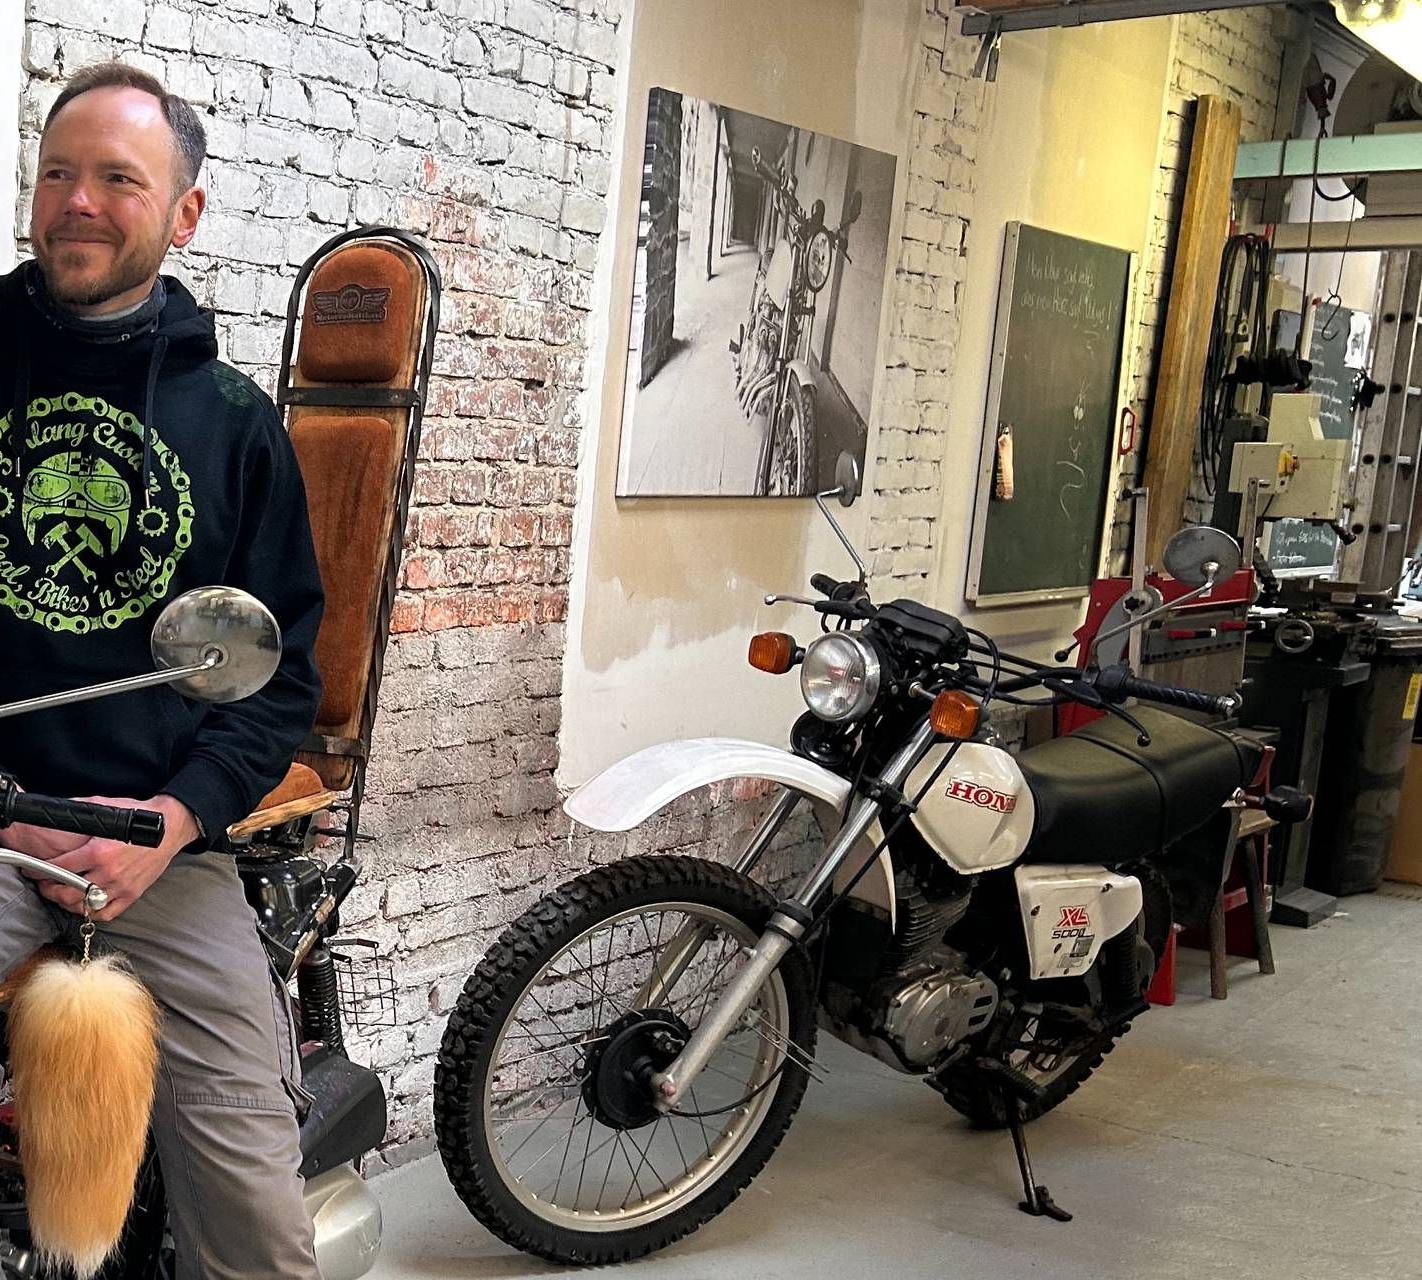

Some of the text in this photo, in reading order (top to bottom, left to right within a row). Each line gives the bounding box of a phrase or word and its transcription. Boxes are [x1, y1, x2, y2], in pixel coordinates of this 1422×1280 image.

[8, 420, 89, 449] lang
[27, 577, 90, 612] Bikes
[114, 545, 162, 598] Steel
[1057, 904, 1090, 928] XL
